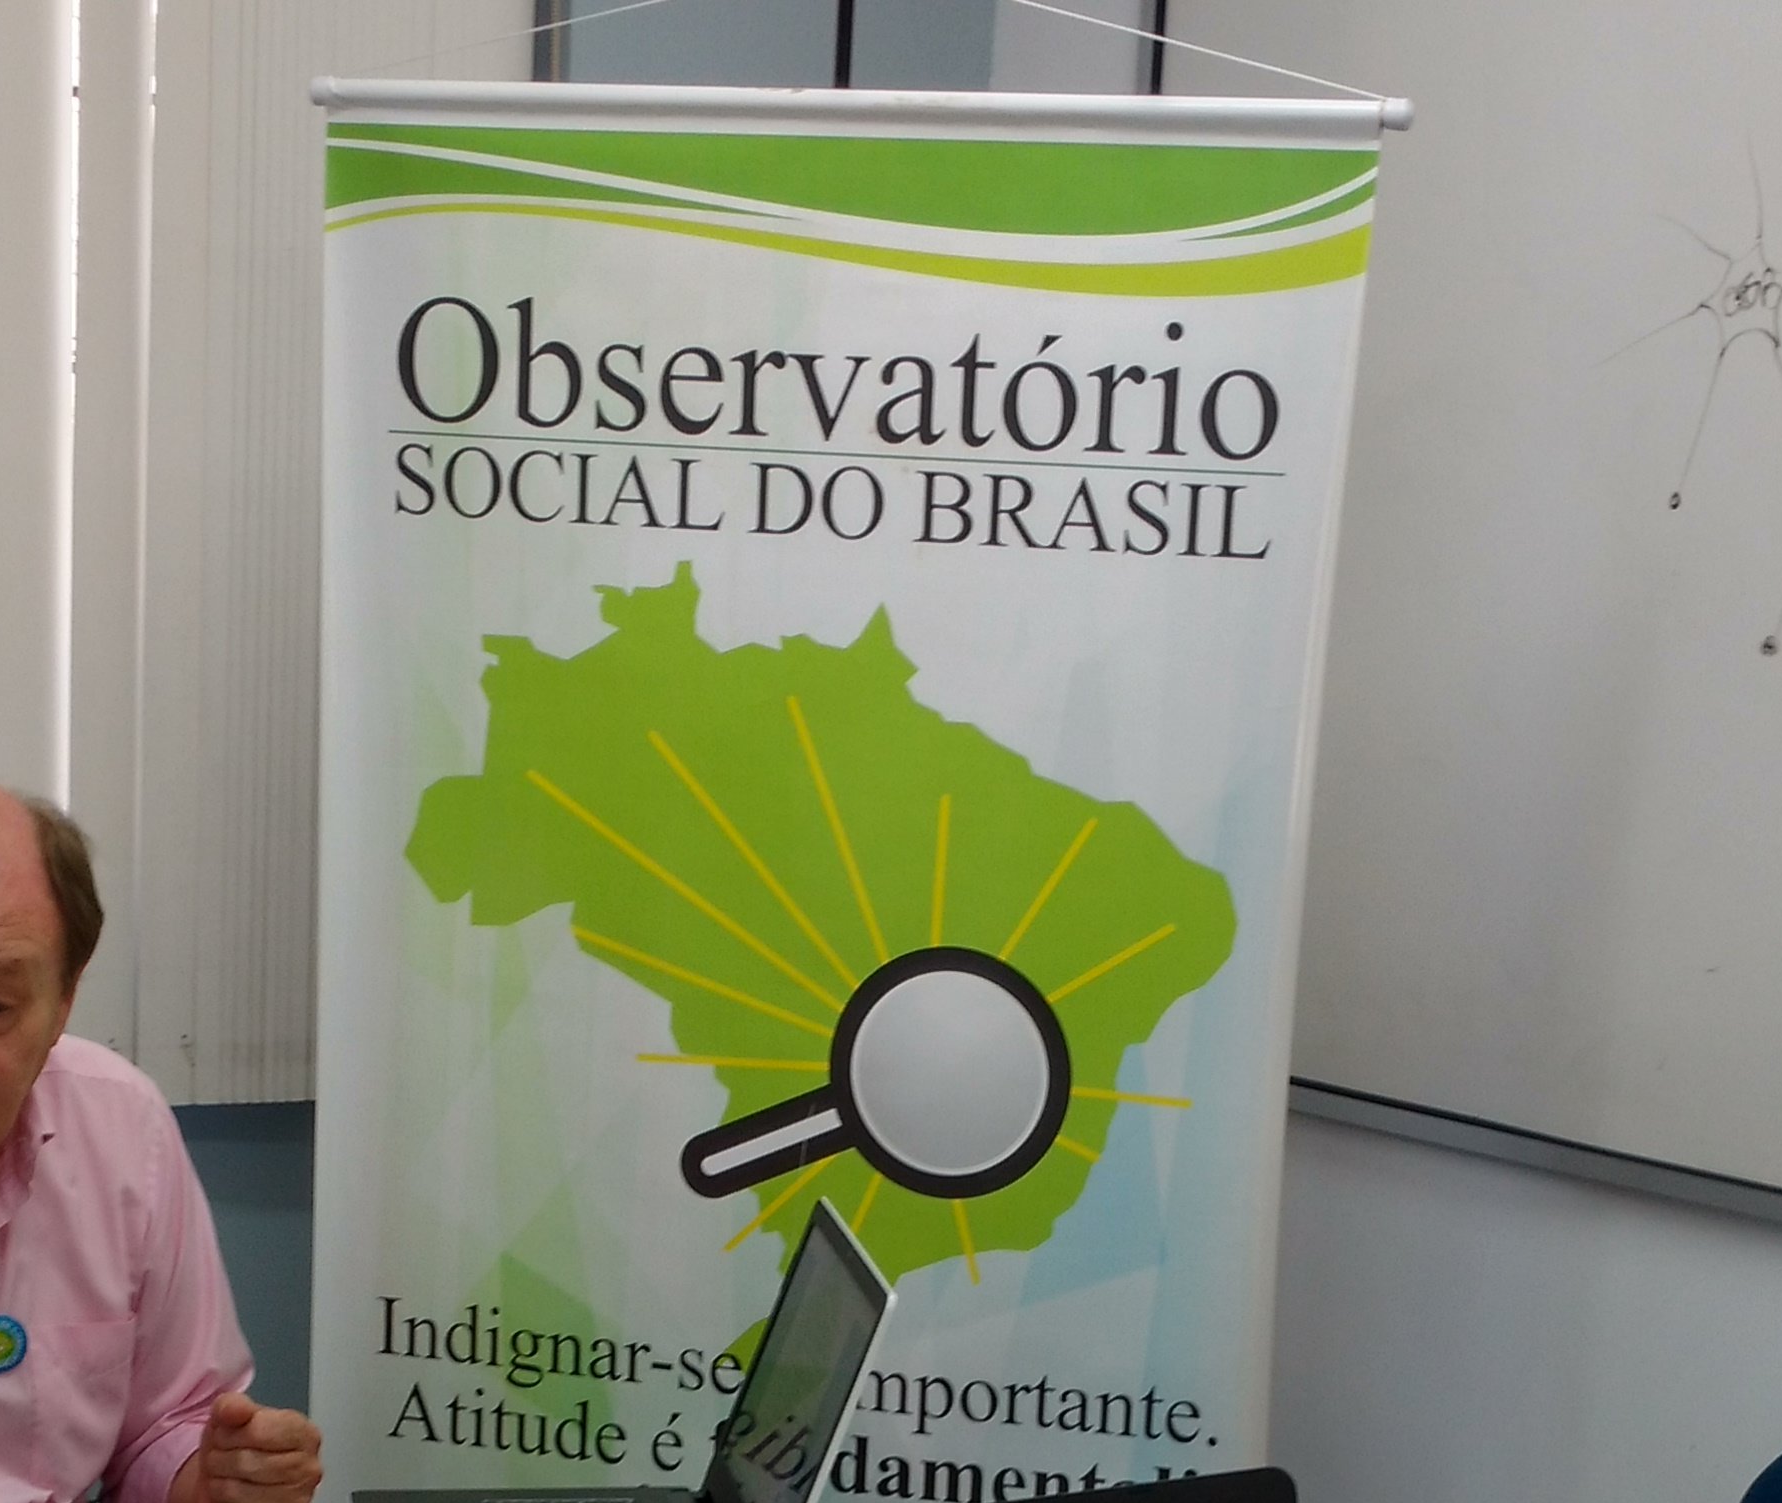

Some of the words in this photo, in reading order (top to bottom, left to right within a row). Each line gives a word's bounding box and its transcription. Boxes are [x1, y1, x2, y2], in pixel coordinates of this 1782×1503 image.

[397, 295, 1281, 462] Observatório
[395, 442, 726, 532] SOCIAL
[747, 461, 885, 542] DO
[913, 469, 1274, 560] BRASIL
[378, 1295, 744, 1396] Indignar-se
[855, 1366, 1219, 1448] mportante.
[387, 1380, 628, 1464] Atitude
[651, 1410, 684, 1472] é
